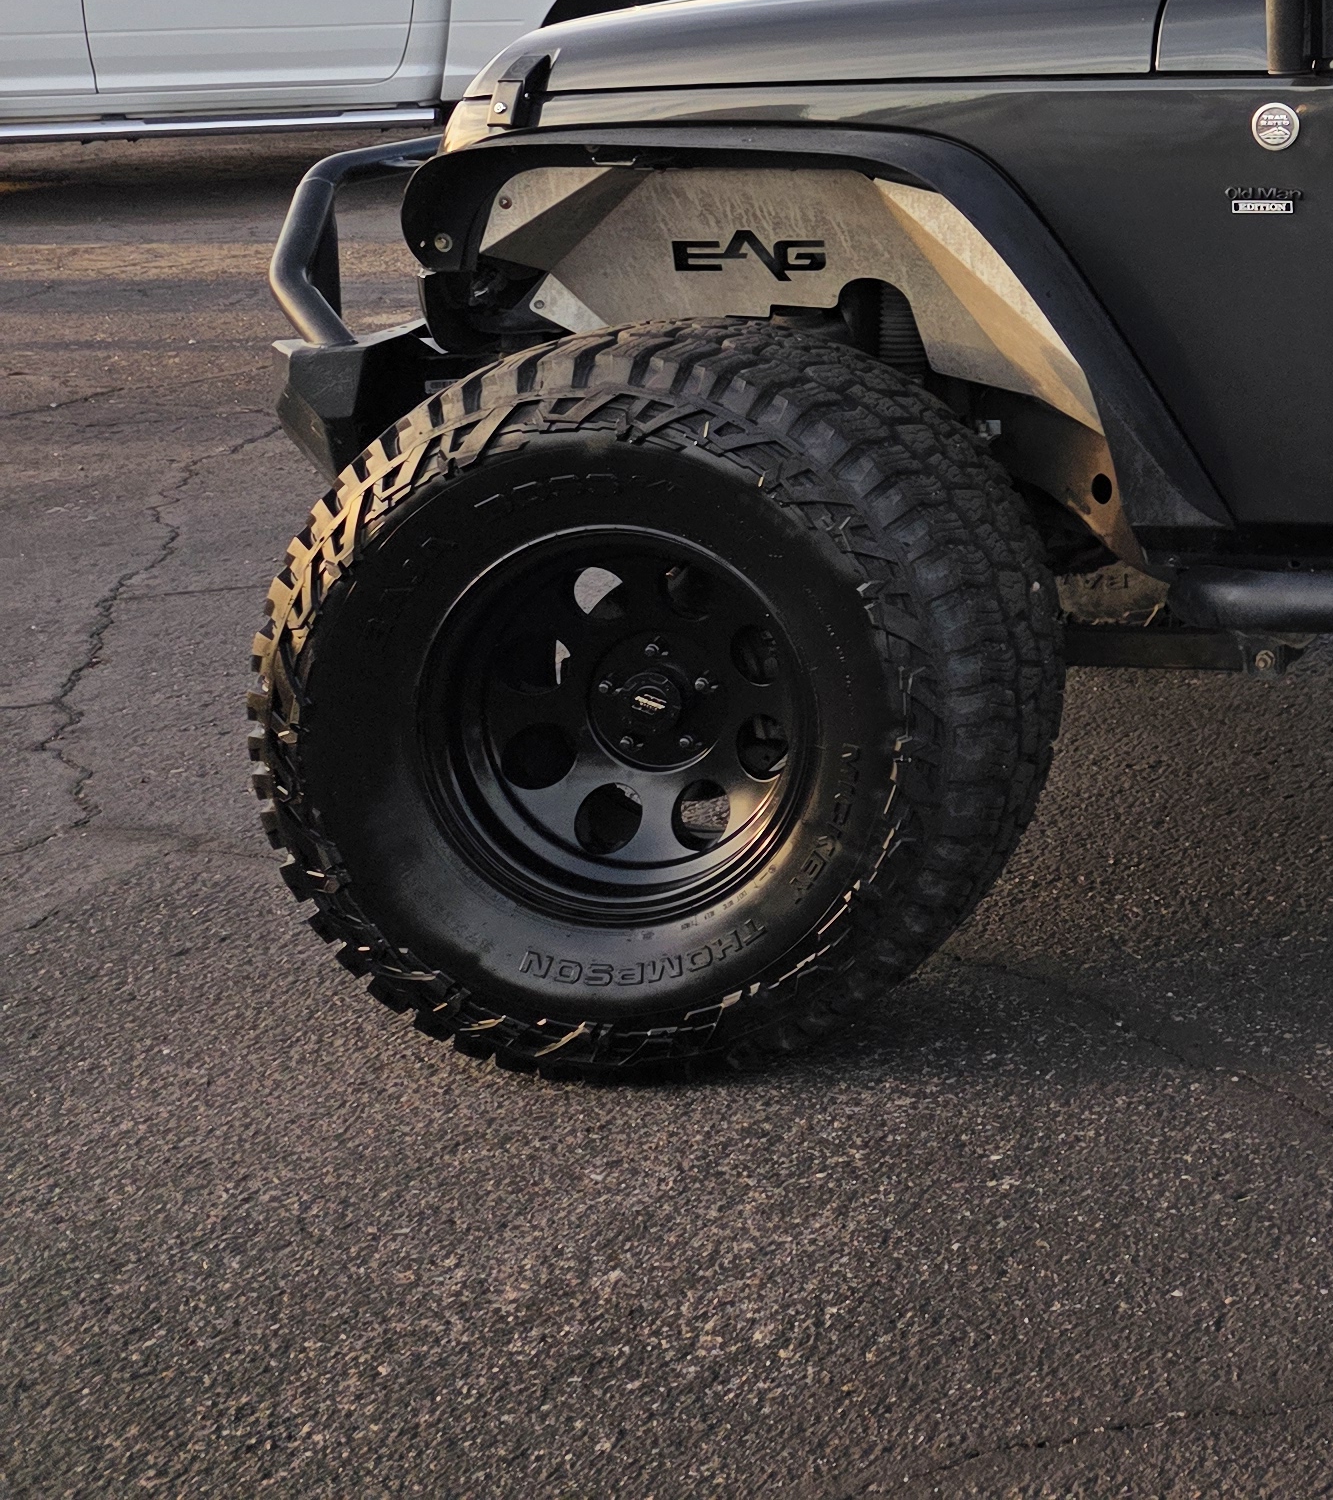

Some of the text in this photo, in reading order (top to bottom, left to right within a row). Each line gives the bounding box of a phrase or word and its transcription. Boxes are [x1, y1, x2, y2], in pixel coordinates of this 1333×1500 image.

[1224, 186, 1303, 200] Old Man
[1238, 203, 1287, 212] EDITION
[672, 230, 827, 282] EAG
[518, 917, 769, 988] THOMPSON
